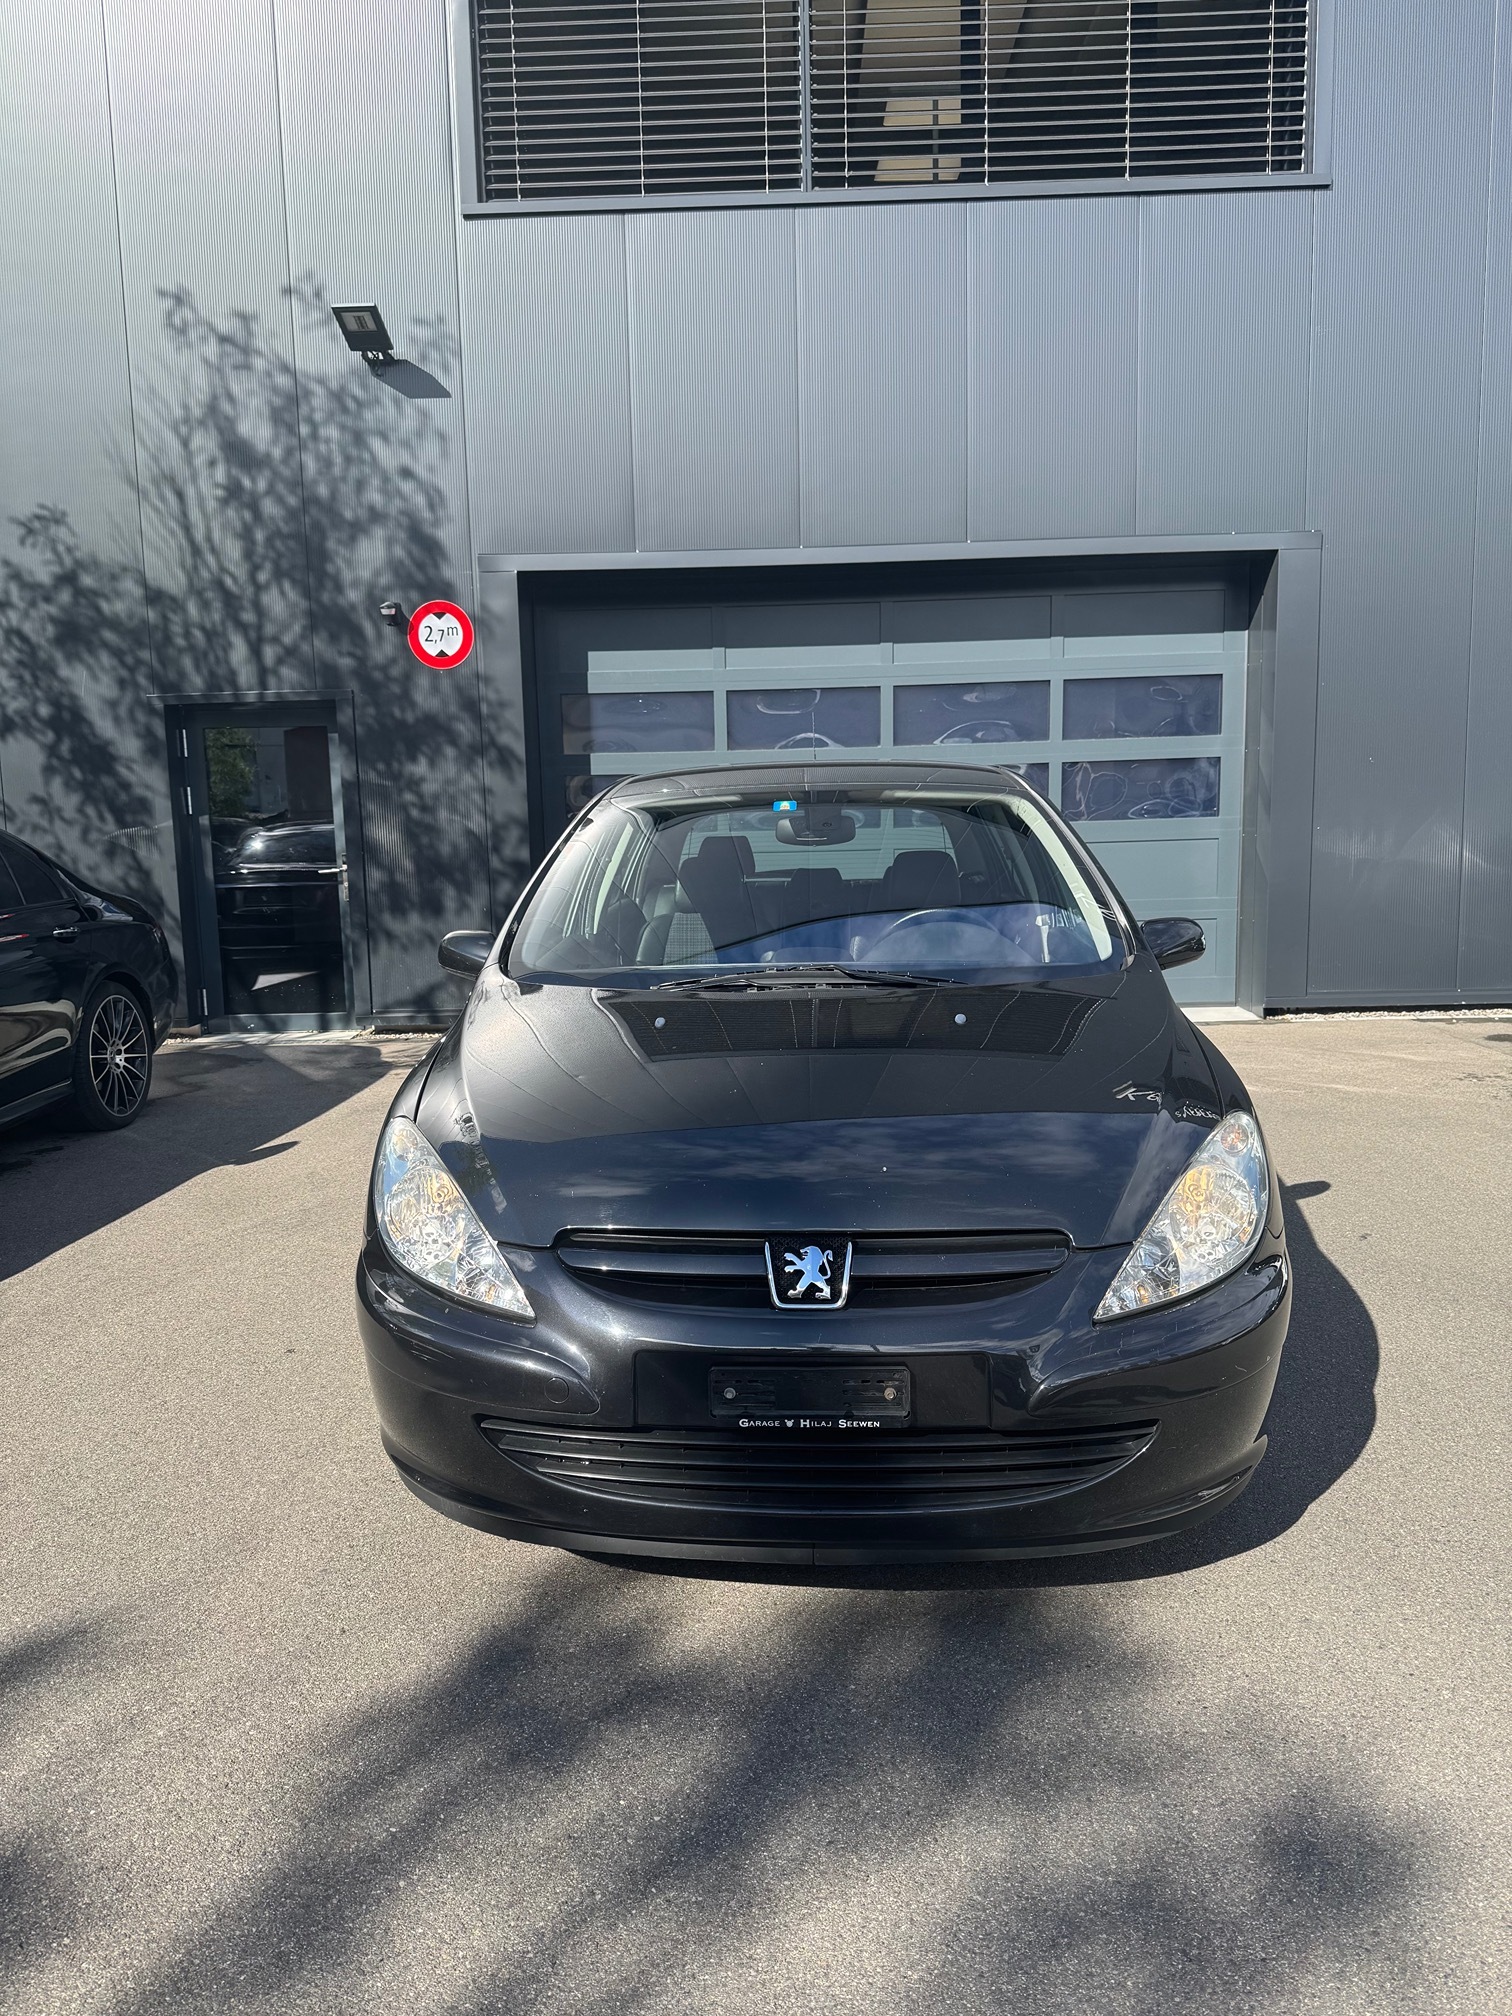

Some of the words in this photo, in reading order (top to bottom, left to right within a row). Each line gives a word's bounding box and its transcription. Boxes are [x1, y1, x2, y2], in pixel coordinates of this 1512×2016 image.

[739, 1418, 781, 1428] GARAGE
[800, 1419, 832, 1428] HILAJ
[838, 1419, 881, 1428] SEEWEN
